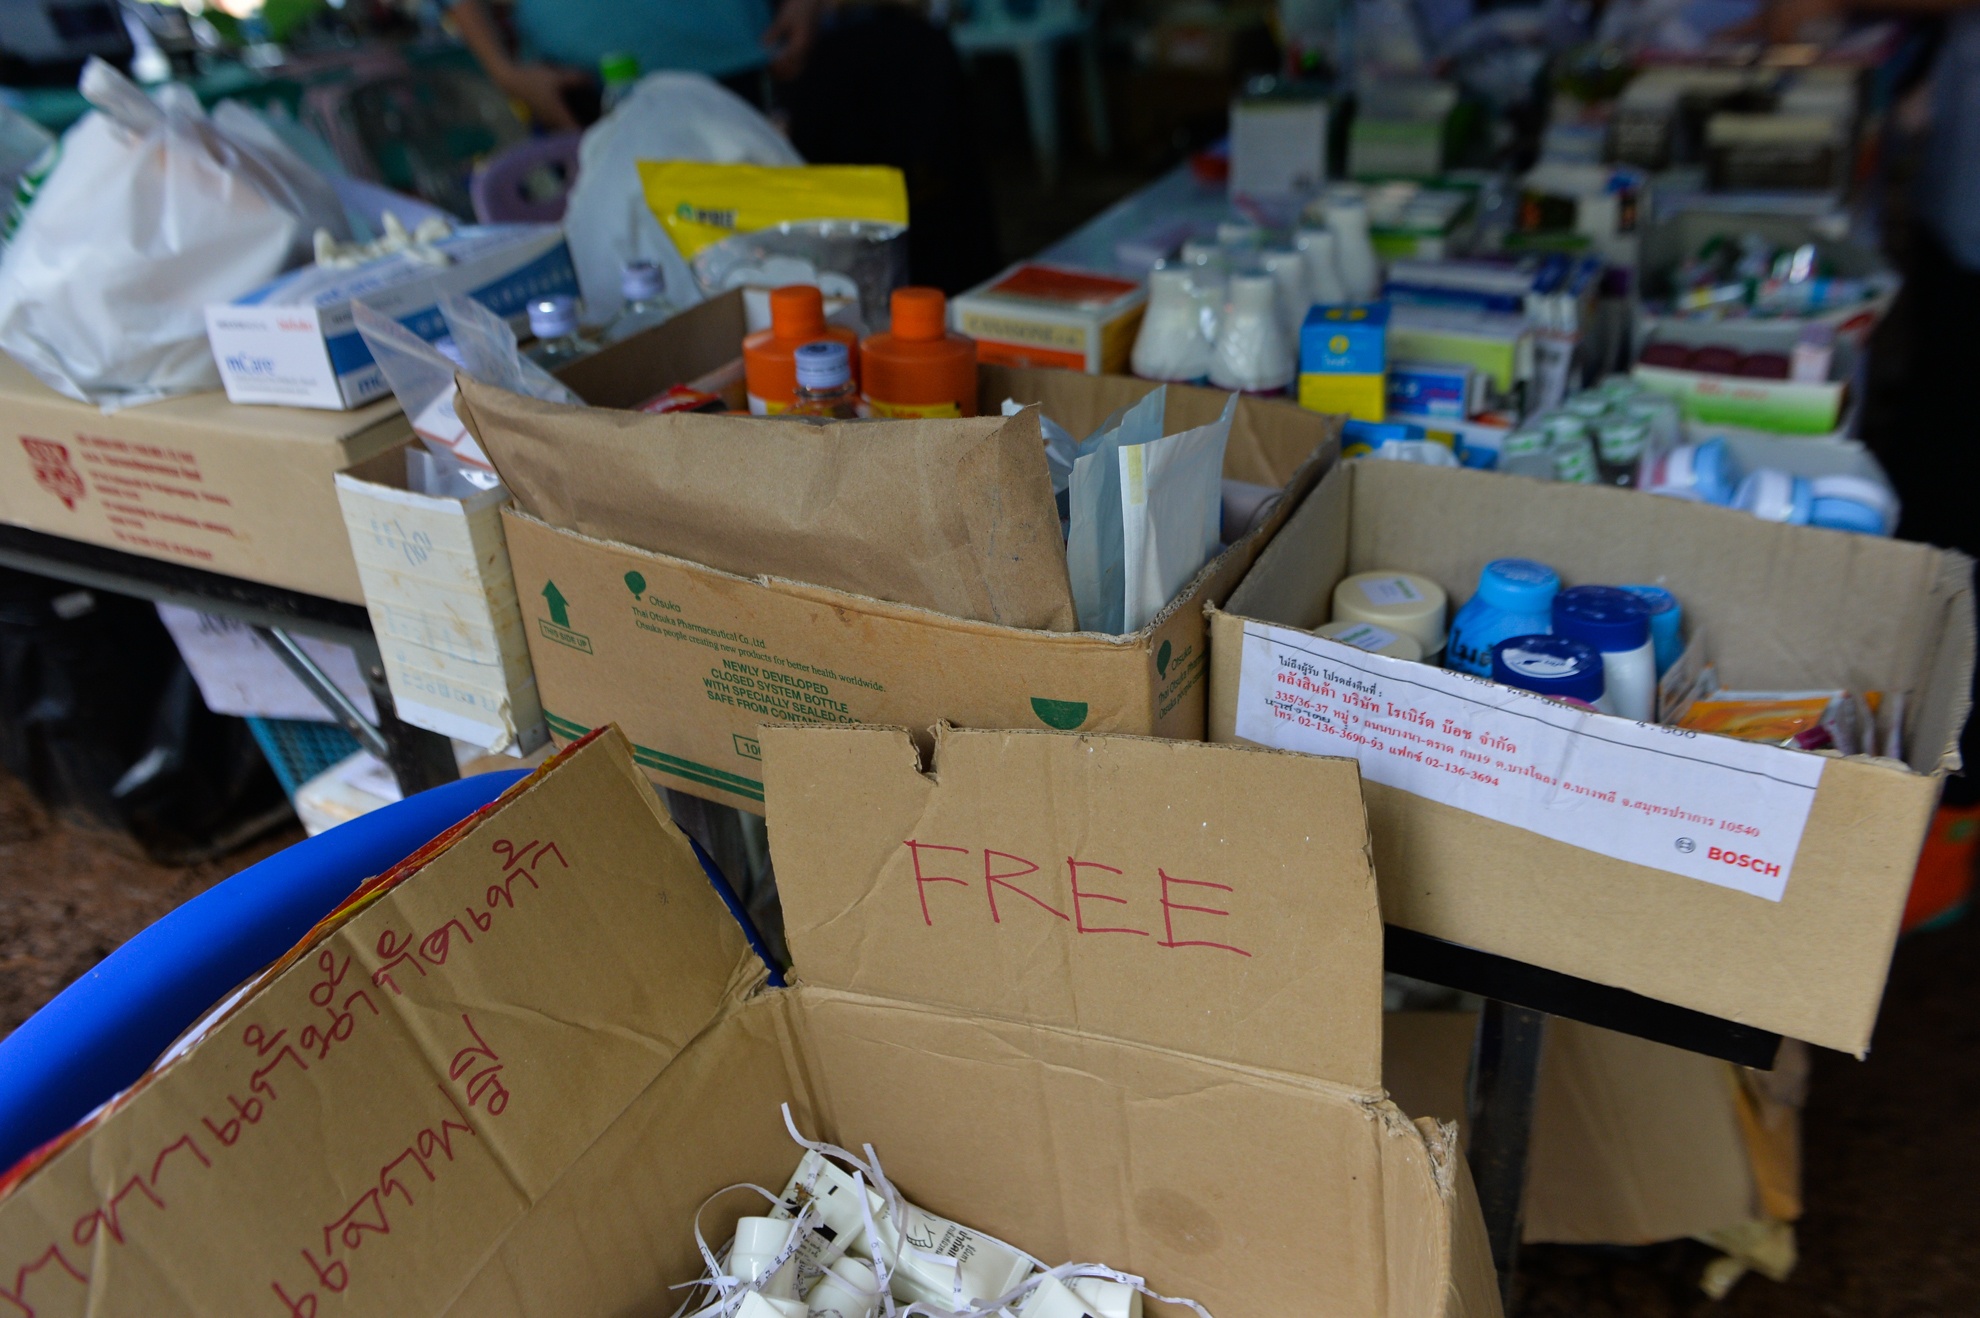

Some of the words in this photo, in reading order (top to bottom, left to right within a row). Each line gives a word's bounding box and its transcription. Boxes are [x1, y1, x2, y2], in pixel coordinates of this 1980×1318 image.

[632, 607, 648, 618] Thai
[650, 612, 676, 626] Otsuka
[677, 619, 737, 642] Pharmaceutical
[649, 596, 681, 612] Otsuka
[543, 625, 559, 638] THIS
[559, 632, 577, 645] SIDE
[577, 638, 587, 648] UP
[636, 620, 662, 634] Otsuka
[663, 628, 687, 641] people
[689, 636, 719, 651] creating
[720, 644, 736, 653] new
[738, 648, 771, 662] products
[773, 655, 785, 666] for
[786, 659, 809, 673] better
[811, 665, 837, 680] health
[839, 674, 886, 693] worldwide.
[702, 677, 730, 693] WITH
[733, 685, 790, 708] SPECIALLY
[792, 702, 836, 722] SEALED
[711, 668, 755, 688] CLOSED
[757, 680, 801, 701] SYSTEM
[804, 692, 849, 714] BOTTLE
[722, 659, 759, 677] NEWLY
[762, 669, 829, 695] DEVELOPED
[707, 690, 735, 705] SAFE
[737, 698, 768, 715] FROM
[1277, 671, 1336, 698] คลังสินค้า
[1343, 692, 1380, 713] บริษัท
[1387, 702, 1435, 729] โรเบิร์ต
[1479, 731, 1517, 754] จำกัด
[1274, 704, 1295, 722] โทร.
[1298, 716, 1384, 751] 02-136-3690-93
[1389, 745, 1423, 763] แฟกซ์
[1425, 756, 1499, 786] 02-136-3694
[1275, 691, 1328, 714] 335/36-37
[1333, 710, 1349, 725] หมู่
[1352, 715, 1359, 723] 9
[1364, 720, 1454, 754] ถนนบางนา-ตราด
[1719, 820, 1760, 837] 10540
[1707, 846, 1782, 878] BOSCH
[903, 839, 1252, 957] FREE
